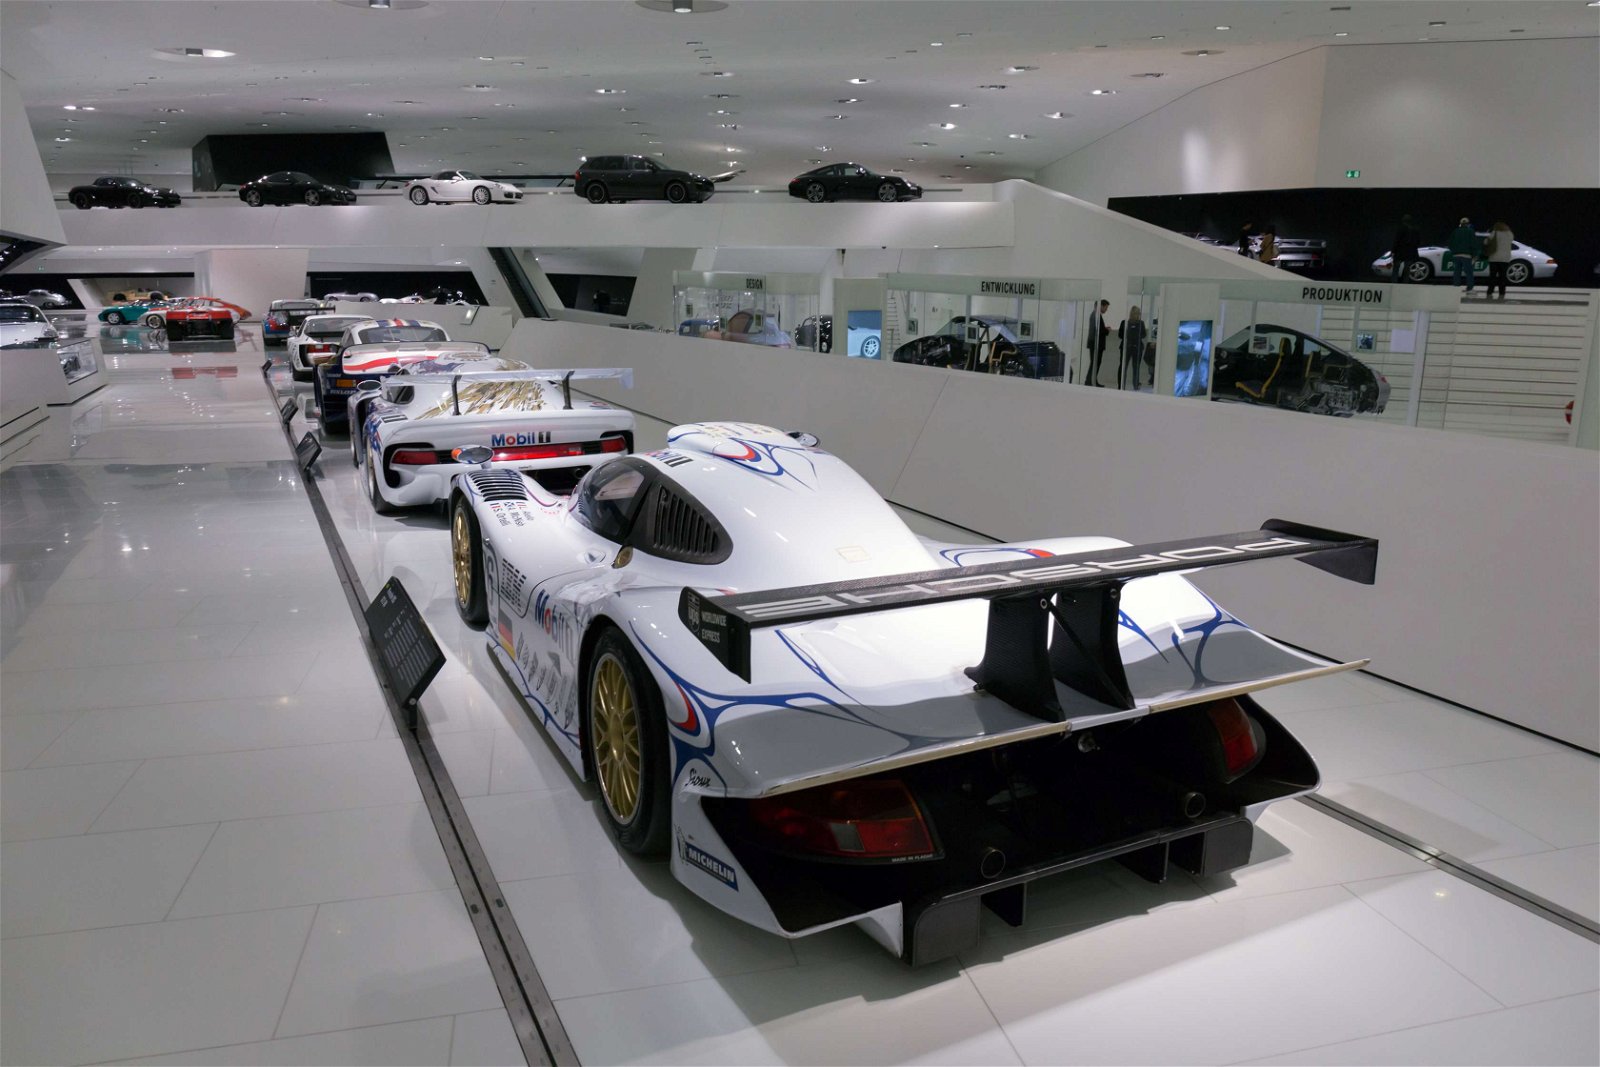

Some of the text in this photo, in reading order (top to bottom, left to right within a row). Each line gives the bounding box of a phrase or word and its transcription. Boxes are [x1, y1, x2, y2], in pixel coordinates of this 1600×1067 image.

[746, 278, 763, 290] DESIGN
[981, 281, 1035, 295] ENTWICKLUNG
[1302, 287, 1383, 303] PRODUKTION
[491, 431, 535, 447] Mobil
[736, 538, 1310, 619] PORSCHE
[535, 588, 564, 653] Mobil
[701, 610, 727, 627] WORLDWIDE
[701, 628, 720, 644] EXPRESS
[688, 847, 735, 883] MICHELIN
